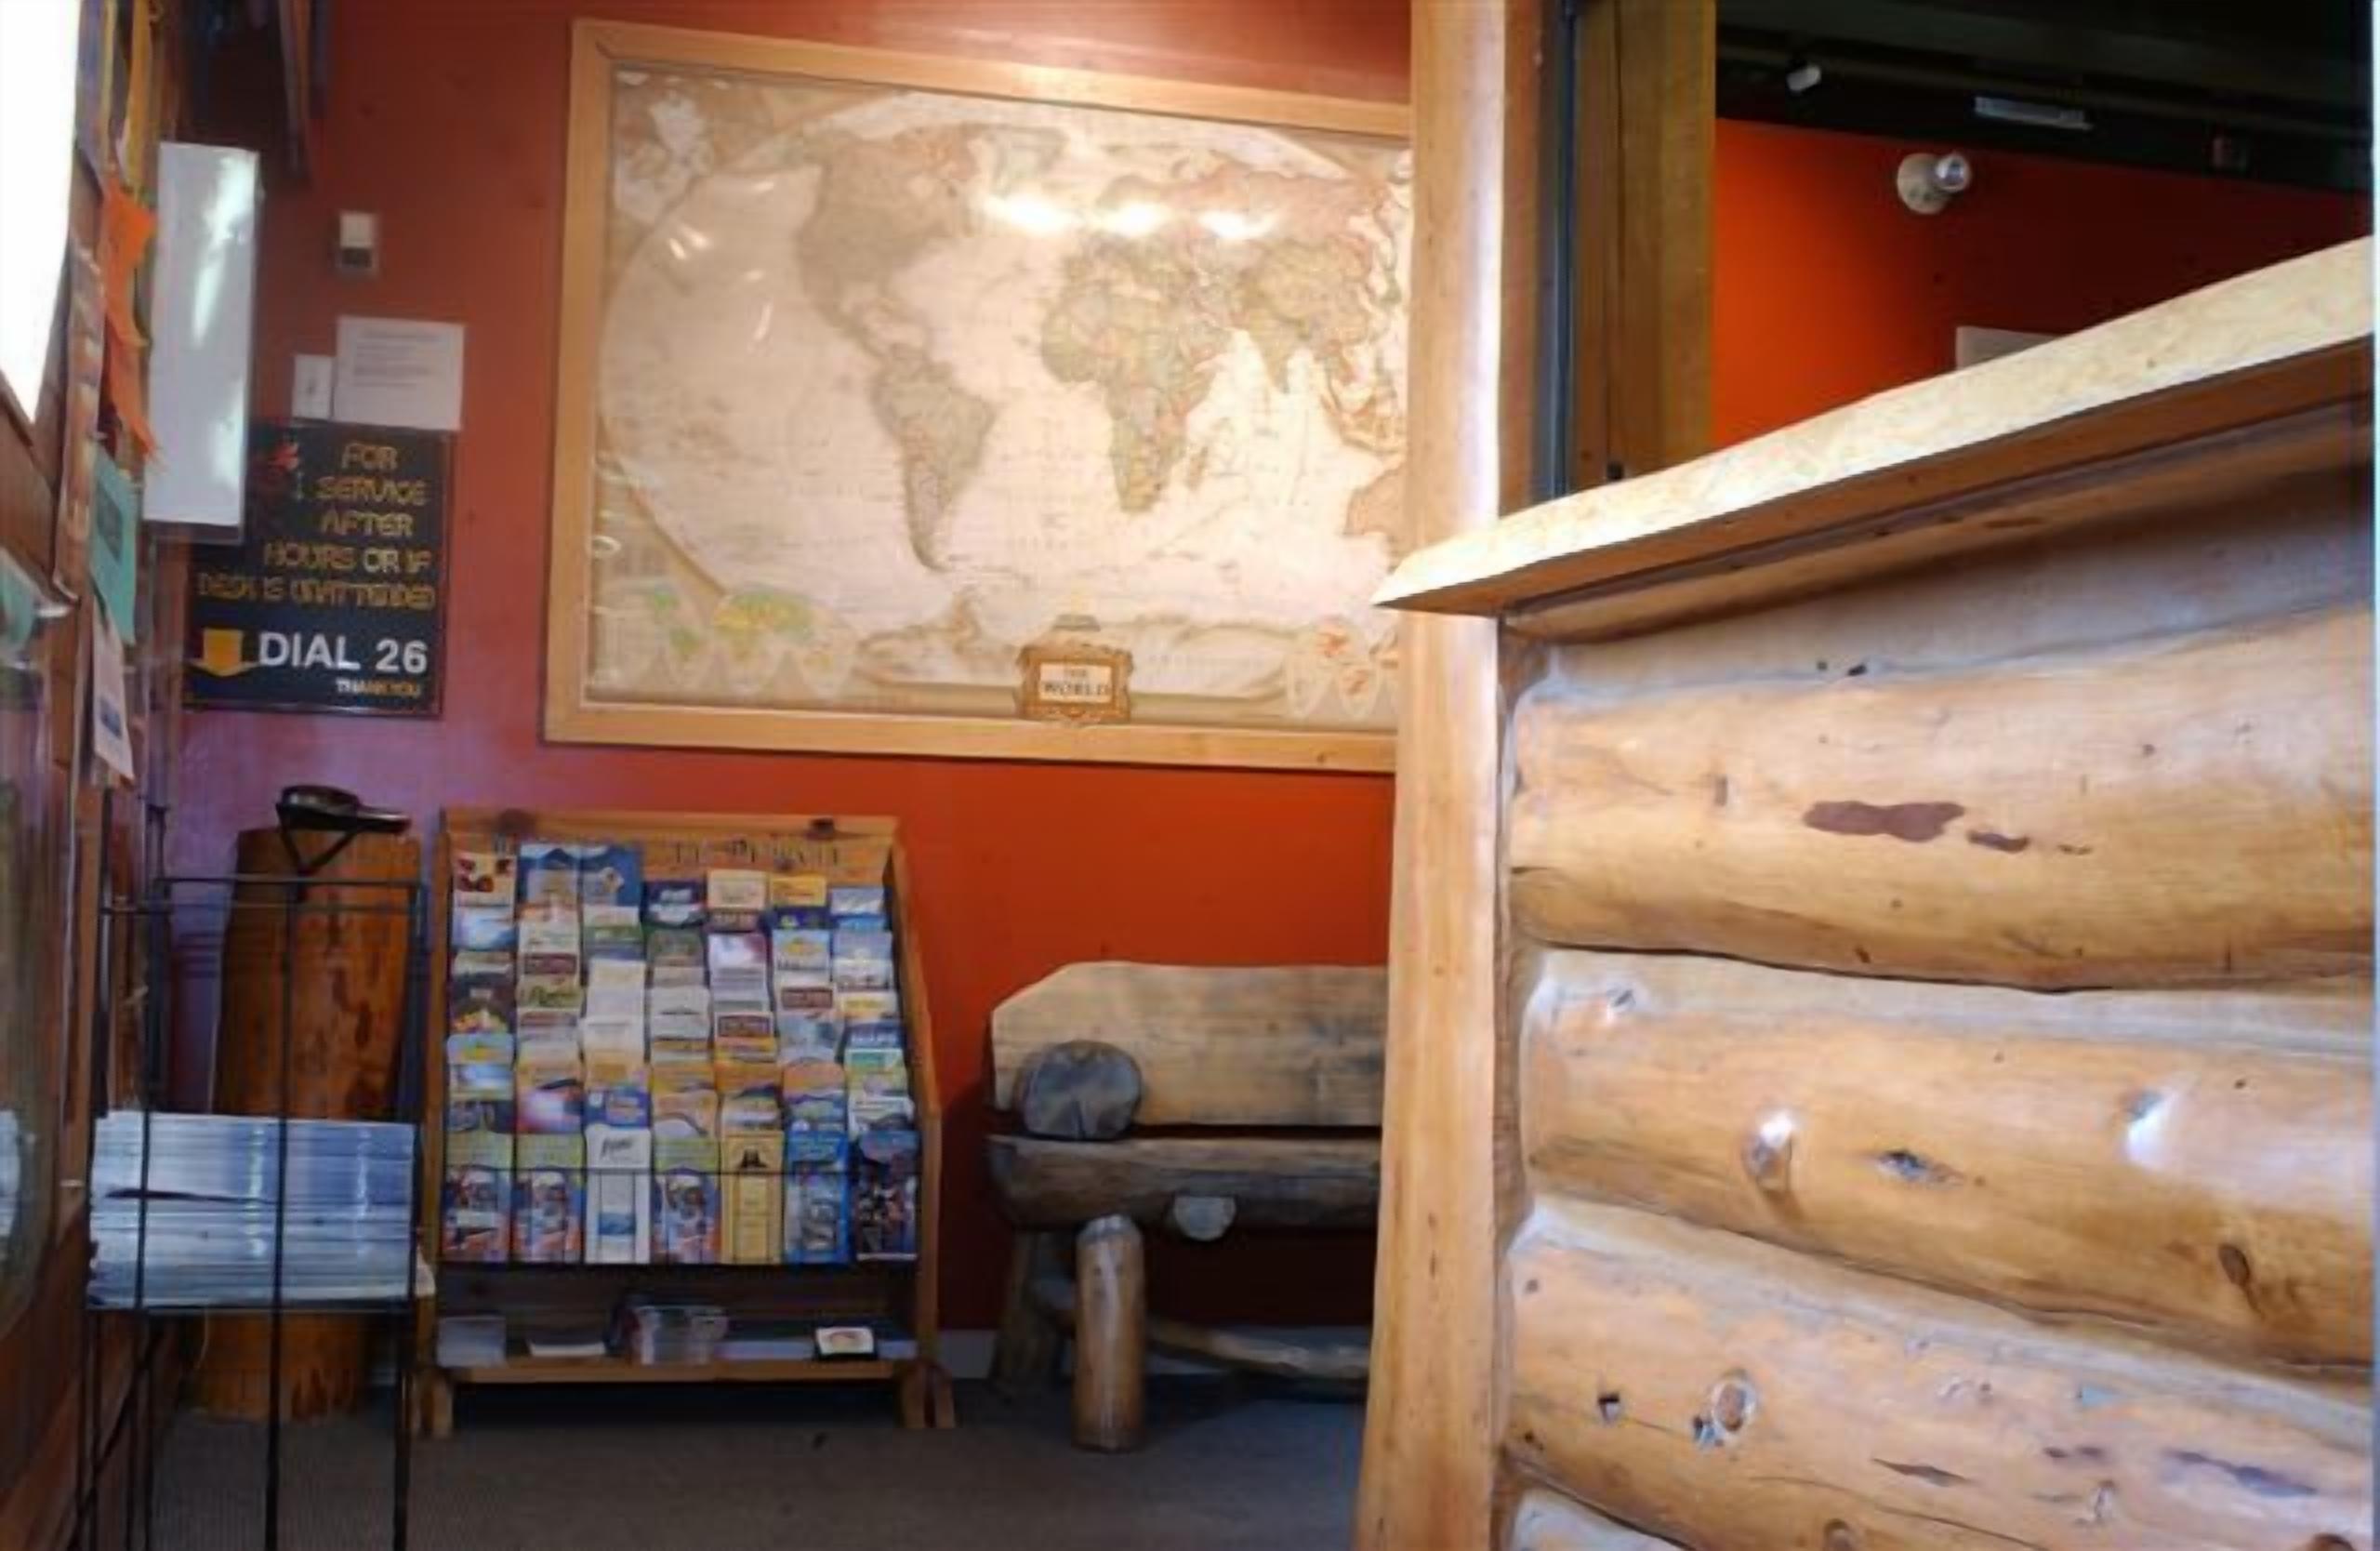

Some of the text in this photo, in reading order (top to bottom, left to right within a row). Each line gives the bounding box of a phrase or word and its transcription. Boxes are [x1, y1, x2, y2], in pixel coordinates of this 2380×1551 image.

[342, 443, 398, 470] FOR
[316, 477, 427, 506] SERVICE
[320, 508, 414, 537] AFTER
[264, 541, 432, 574] HOURS OR IF
[259, 631, 428, 673] DIAL 26
[336, 678, 386, 696] THANK
[1043, 683, 1109, 696] WORLD
